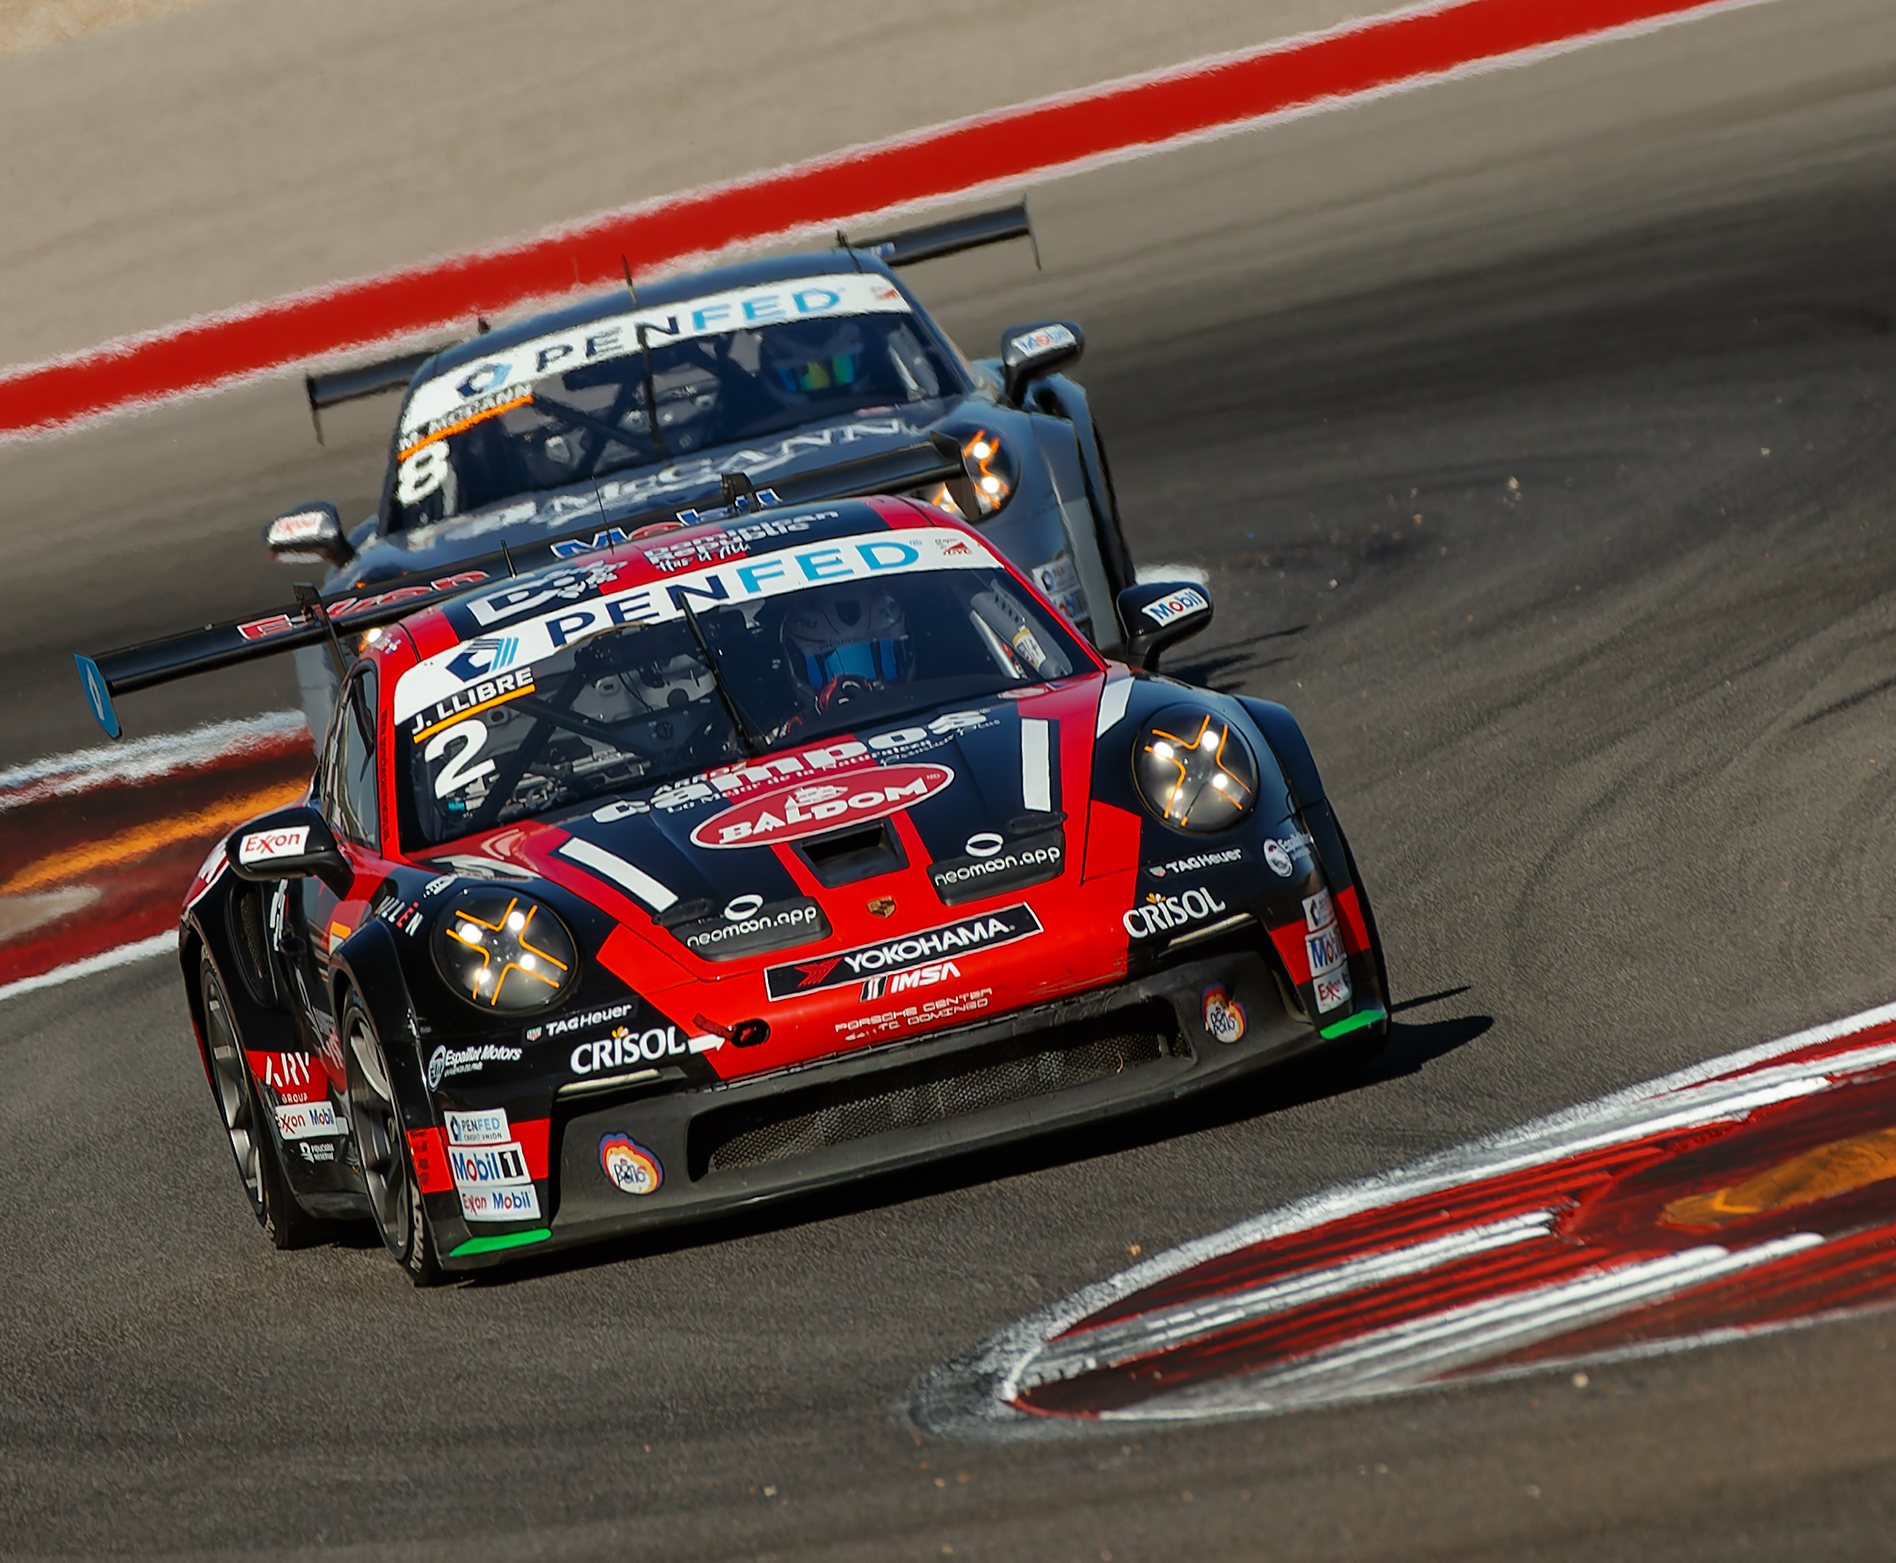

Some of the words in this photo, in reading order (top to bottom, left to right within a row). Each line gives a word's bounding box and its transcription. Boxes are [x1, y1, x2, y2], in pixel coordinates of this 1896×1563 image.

[536, 287, 841, 372] PENFED
[397, 441, 450, 506] 8
[545, 541, 920, 648] PENFED
[1150, 589, 1201, 620] Mobil
[412, 712, 432, 735] J.
[436, 667, 534, 719] LLIBRE
[424, 719, 496, 800] 2
[718, 776, 929, 844] BALDOM
[245, 833, 300, 855] Exxon
[1122, 887, 1226, 939] CRISOL
[843, 918, 1010, 974] YOKOHAMA
[890, 962, 961, 994] IMSA
[834, 1006, 918, 1033] PORSCHE
[922, 987, 993, 1012] CENTER
[481, 1044, 523, 1061] Motors
[570, 1026, 686, 1075] CRISOL
[461, 1117, 501, 1132] PENFED
[452, 1152, 500, 1181] Mobil
[462, 1193, 487, 1215] Exxon
[492, 1191, 531, 1209] Mobil
